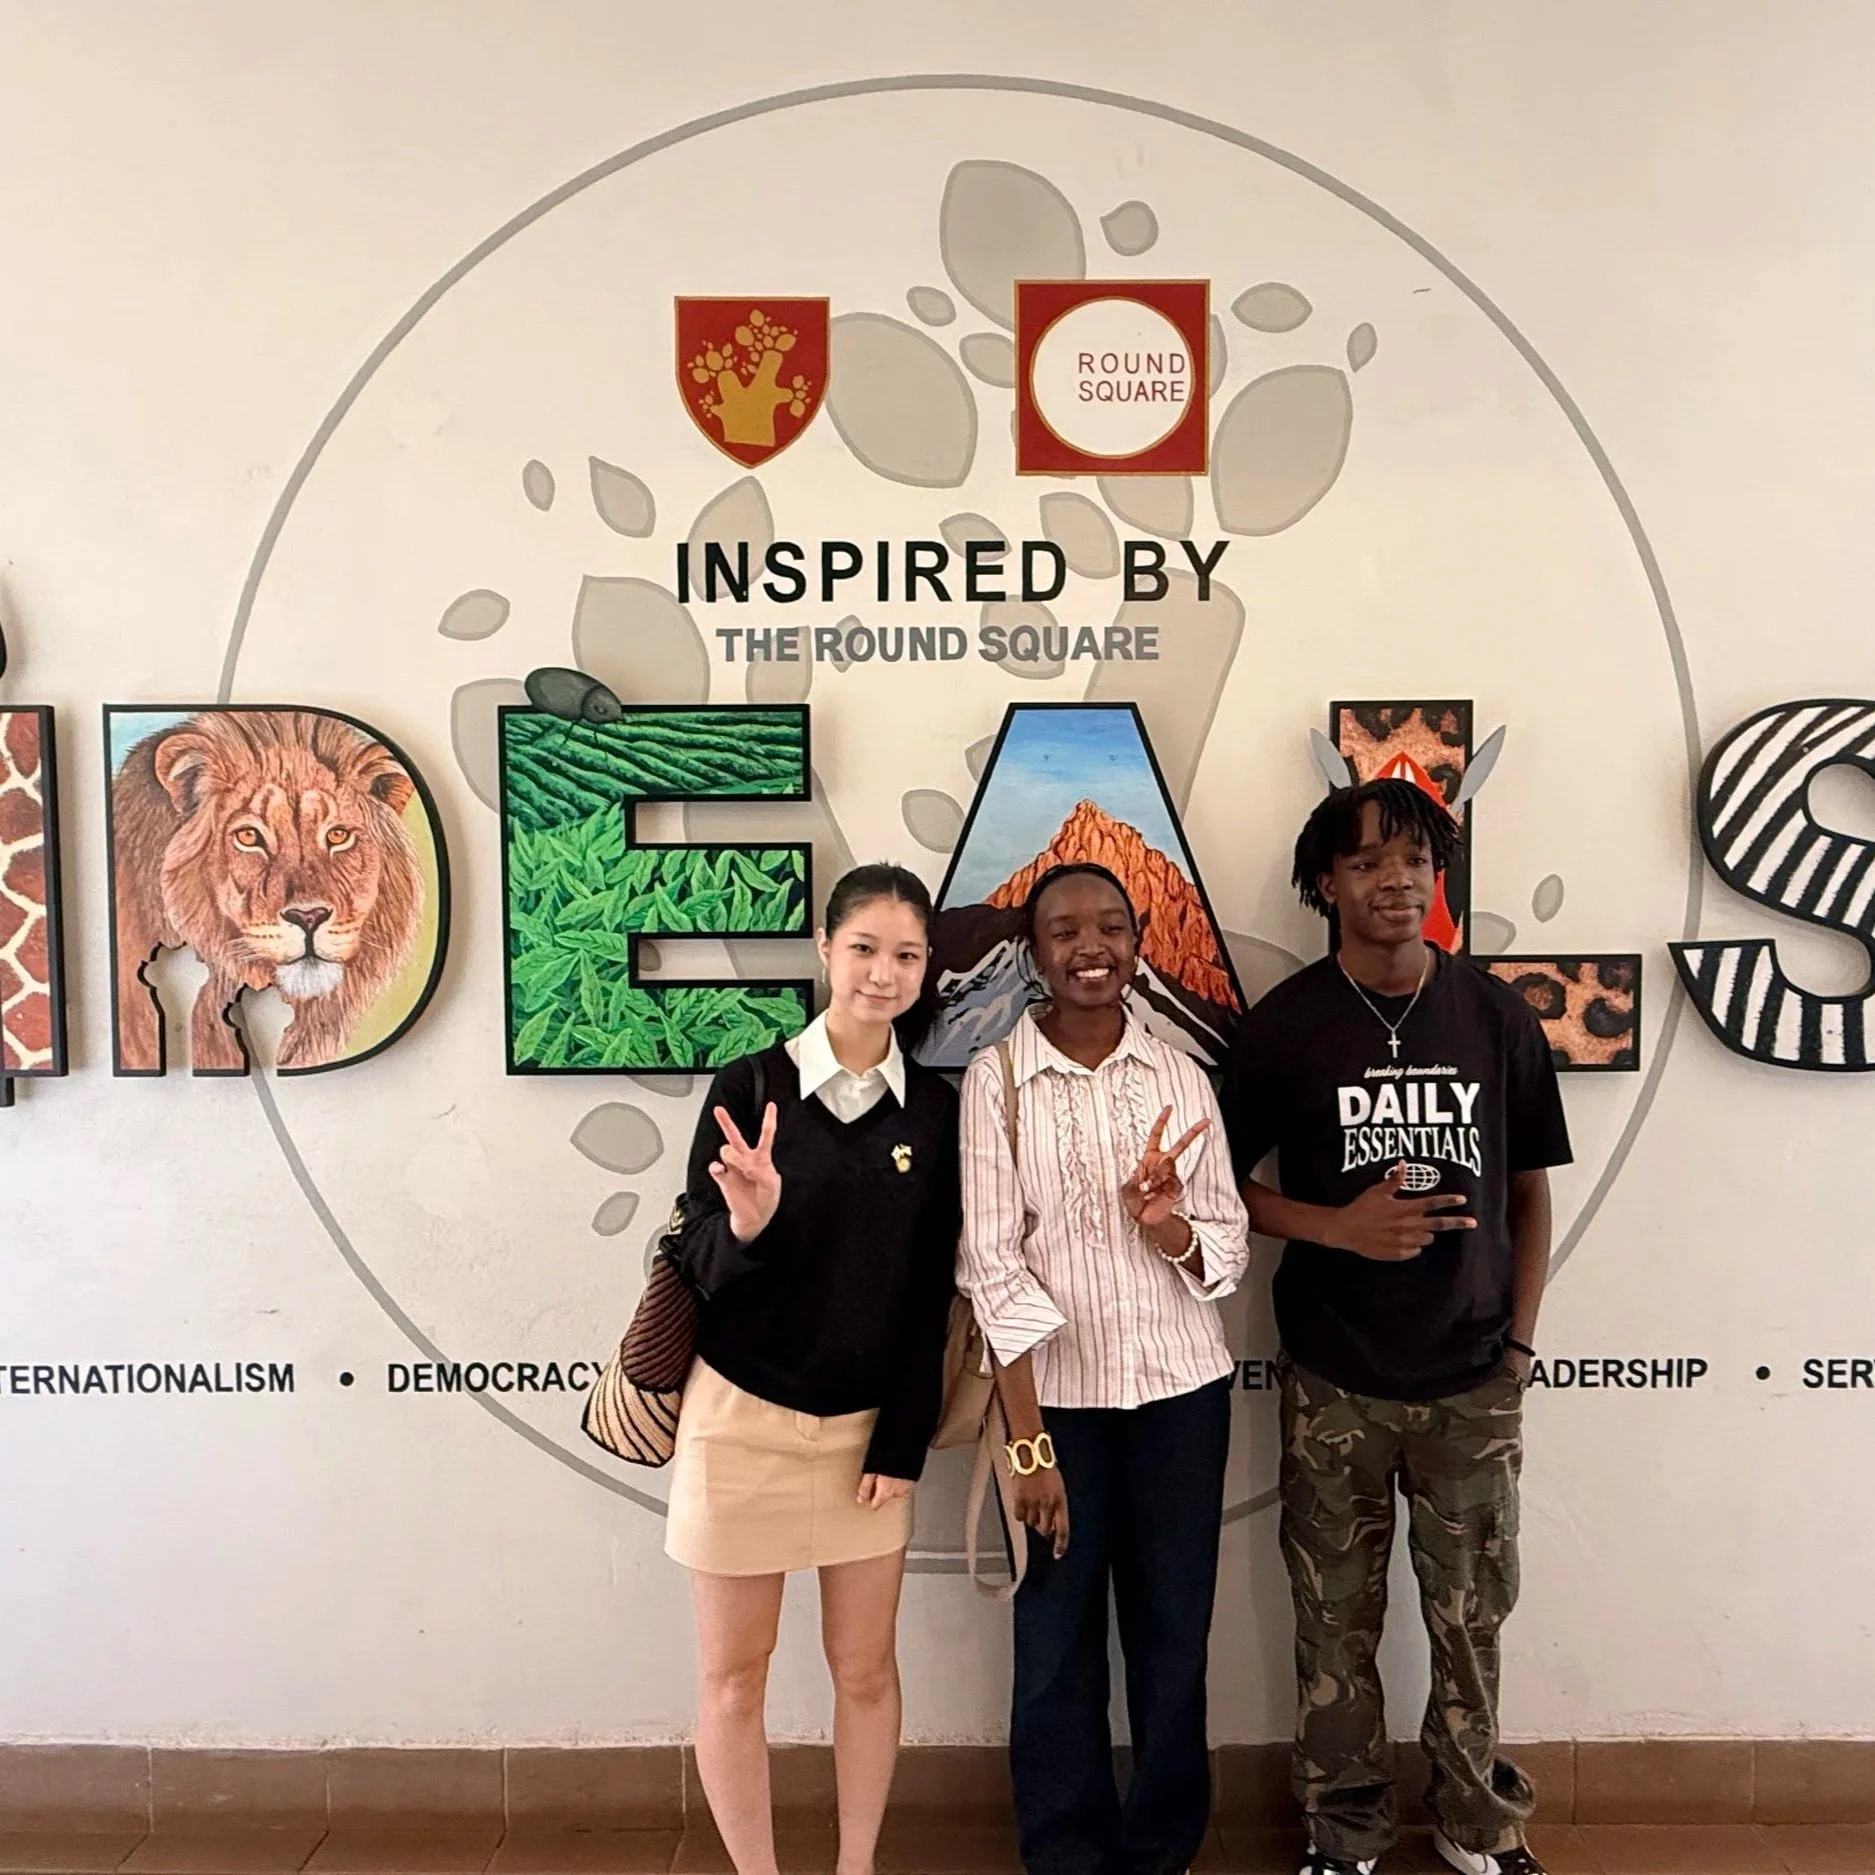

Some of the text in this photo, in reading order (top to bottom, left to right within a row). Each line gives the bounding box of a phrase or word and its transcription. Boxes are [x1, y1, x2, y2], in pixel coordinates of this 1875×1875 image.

[1079, 353, 1185, 374] ROUND
[1079, 380, 1186, 402] SQUARE
[676, 540, 1231, 604] INSPIRED BY
[717, 625, 1160, 662] THE ROUND SQUARE
[1337, 1082, 1480, 1126] DAILY
[1341, 1126, 1482, 1177] ESSENTIALS
[1803, 1359, 1875, 1388] SER
